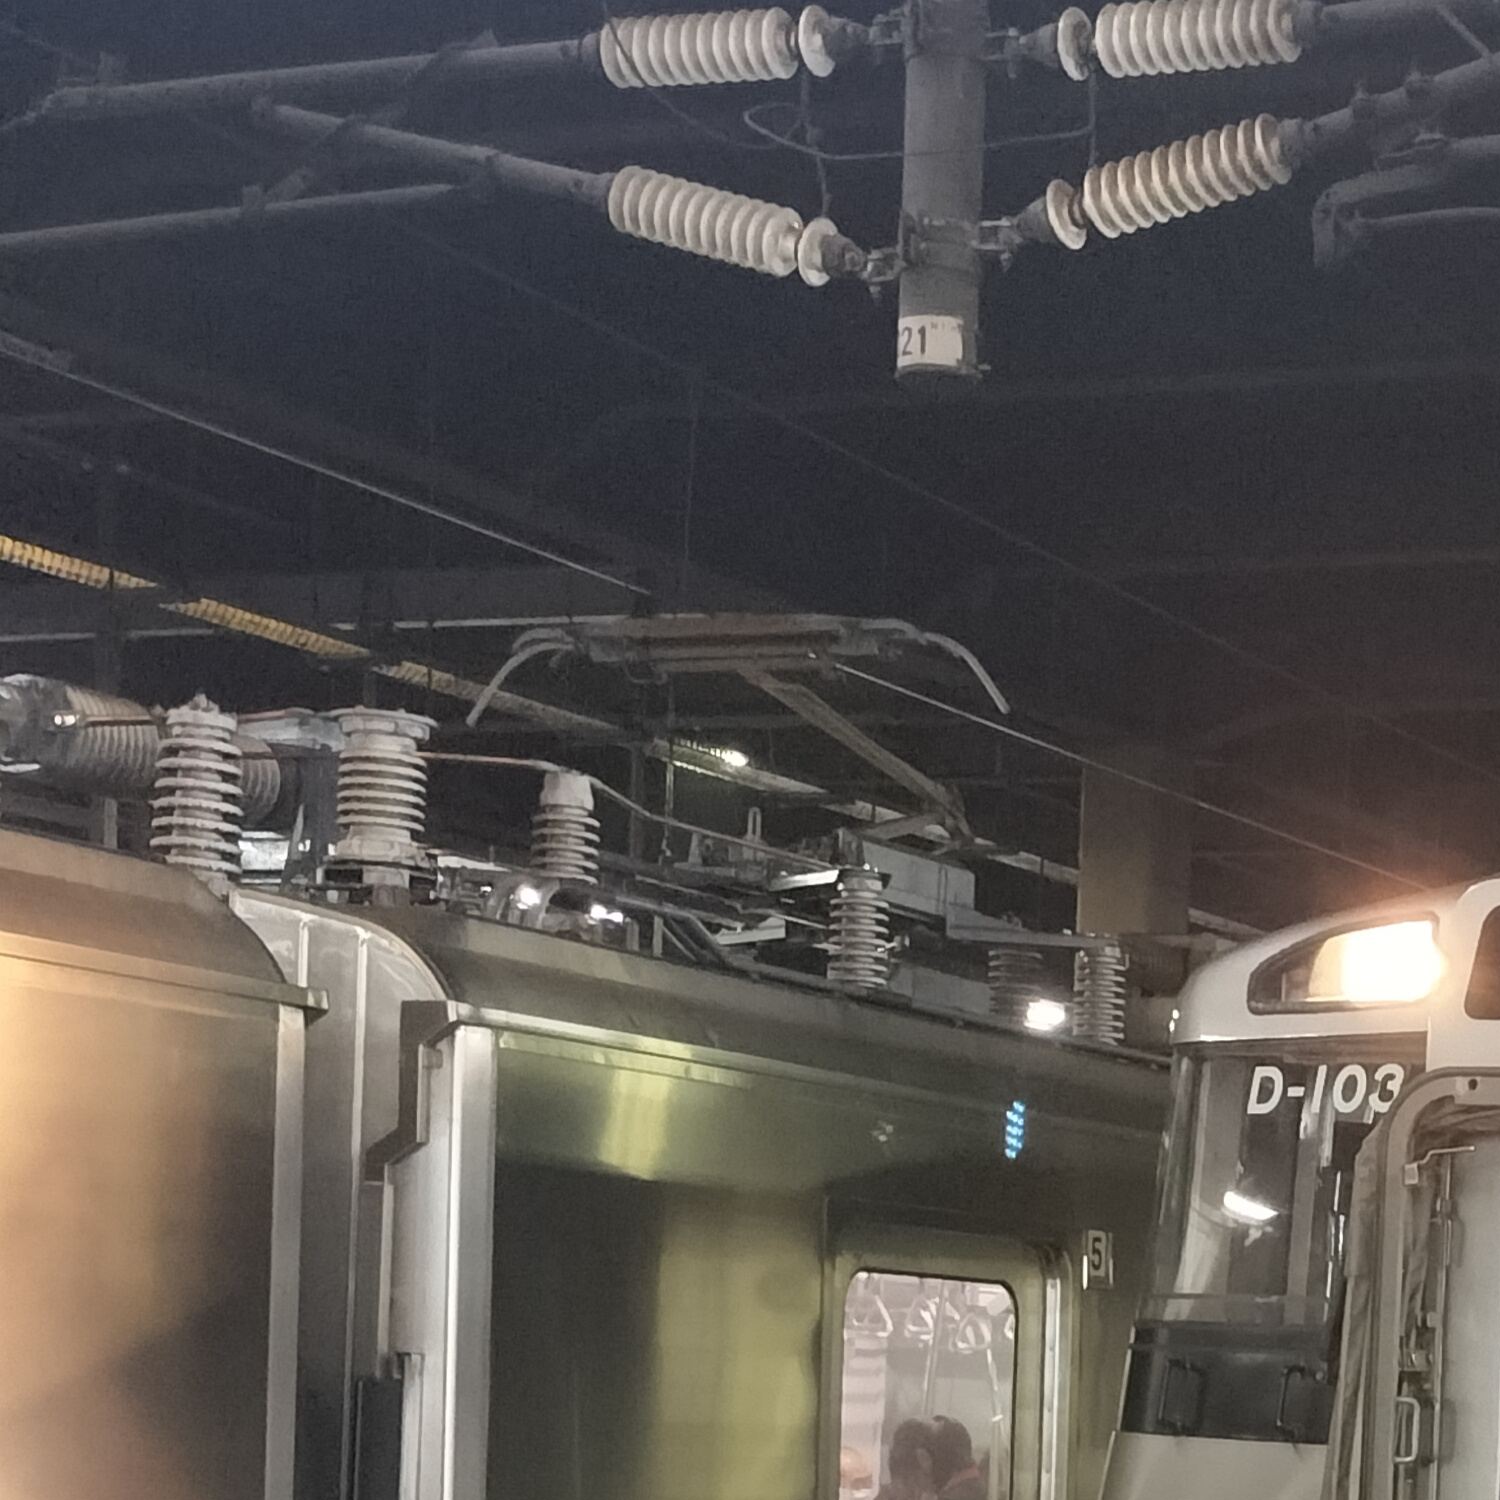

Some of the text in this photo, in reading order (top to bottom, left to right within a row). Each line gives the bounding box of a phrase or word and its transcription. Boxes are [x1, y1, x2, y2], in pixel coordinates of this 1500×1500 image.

[901, 325, 927, 356] 21
[1247, 1063, 1405, 1115] D-103
[1090, 1236, 1103, 1271] 5
